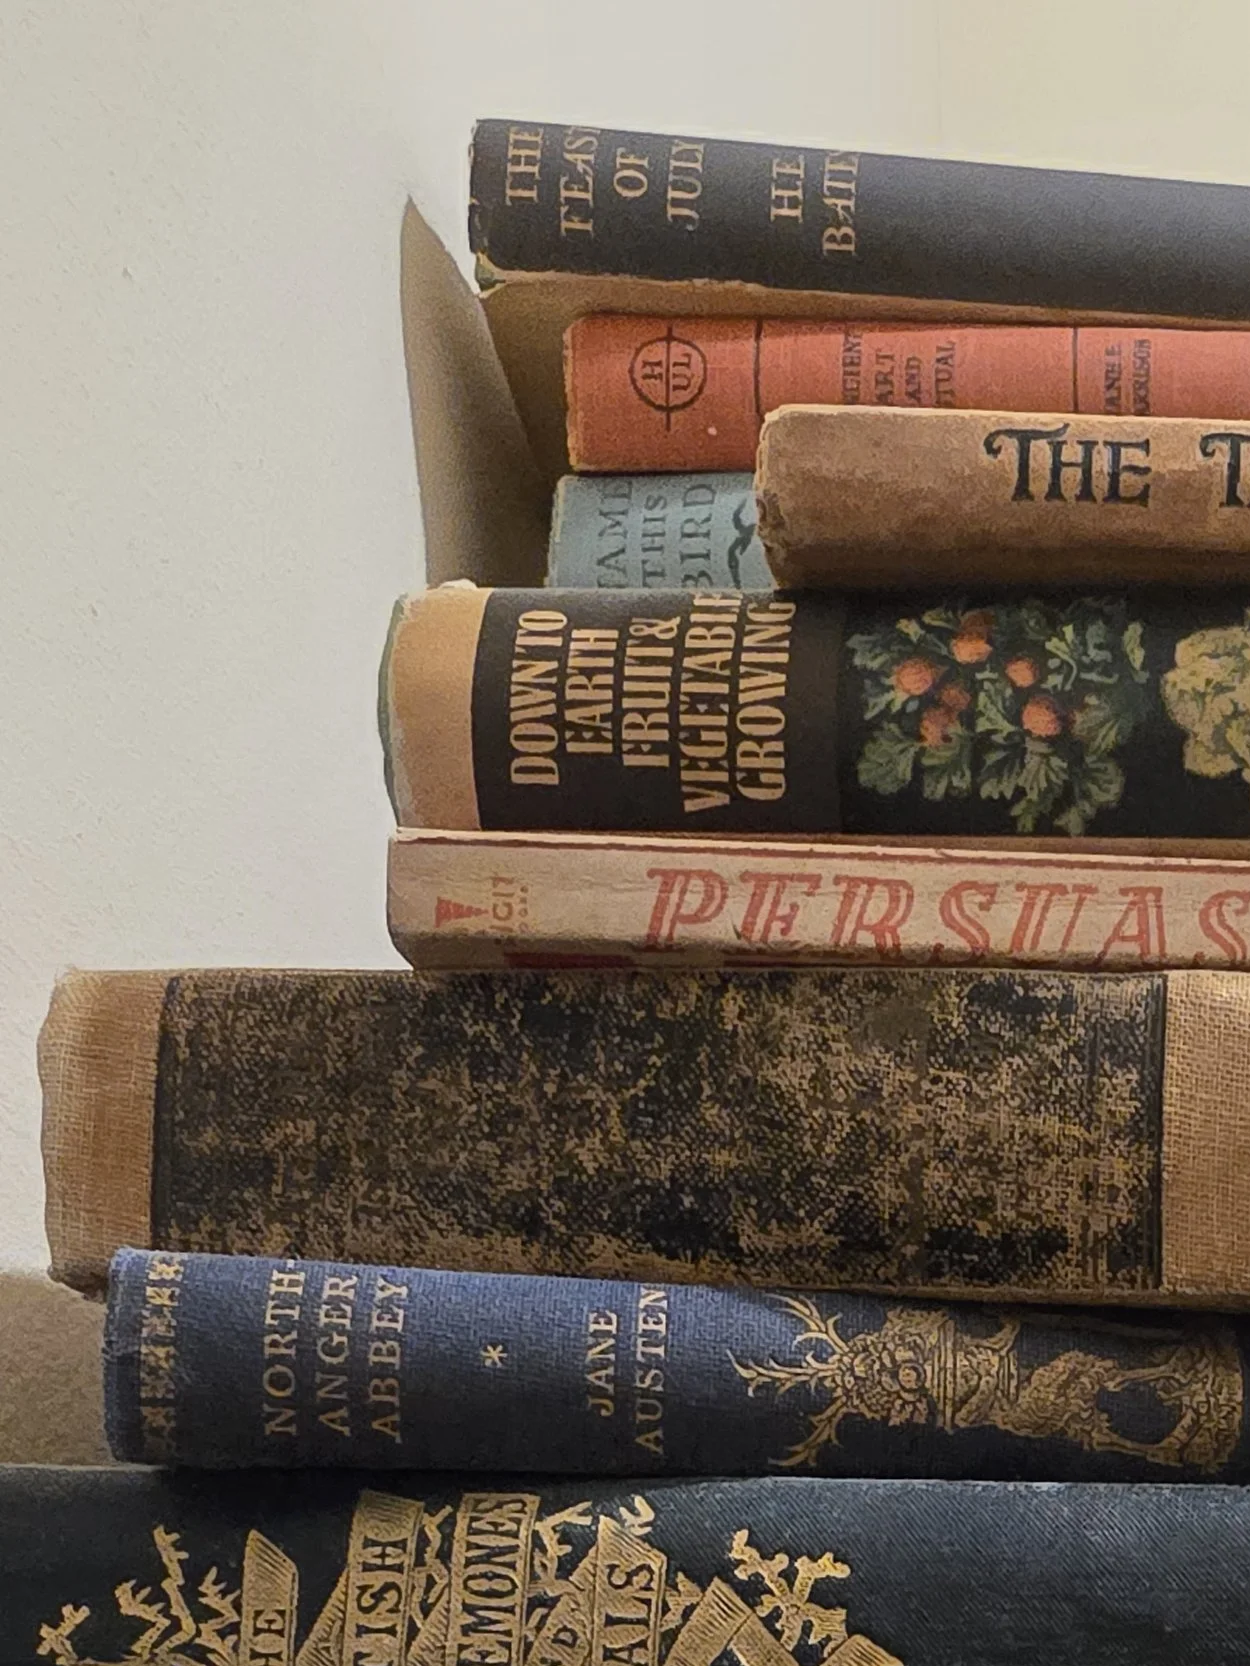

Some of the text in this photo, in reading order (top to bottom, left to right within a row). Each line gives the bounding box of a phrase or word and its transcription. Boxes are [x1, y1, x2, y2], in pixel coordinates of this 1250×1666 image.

[505, 125, 545, 206] THE
[613, 147, 650, 199] OF
[666, 138, 705, 231] JULY
[641, 358, 665, 382] H
[672, 352, 694, 392] UL
[874, 351, 896, 406] ART
[904, 354, 924, 404] AND
[983, 421, 1152, 508] THE
[641, 494, 667, 589] THIS
[509, 609, 568, 786] DOWN TO
[563, 628, 620, 754] EARTH
[621, 615, 681, 768] FRUIT &
[678, 591, 744, 813] VEGETABLE
[735, 600, 797, 802] GROWING
[314, 1274, 358, 1438] ANGER
[367, 1274, 409, 1445] ABBEY
[585, 1309, 619, 1418] JANE
[635, 1285, 669, 1456] AUSTEN
